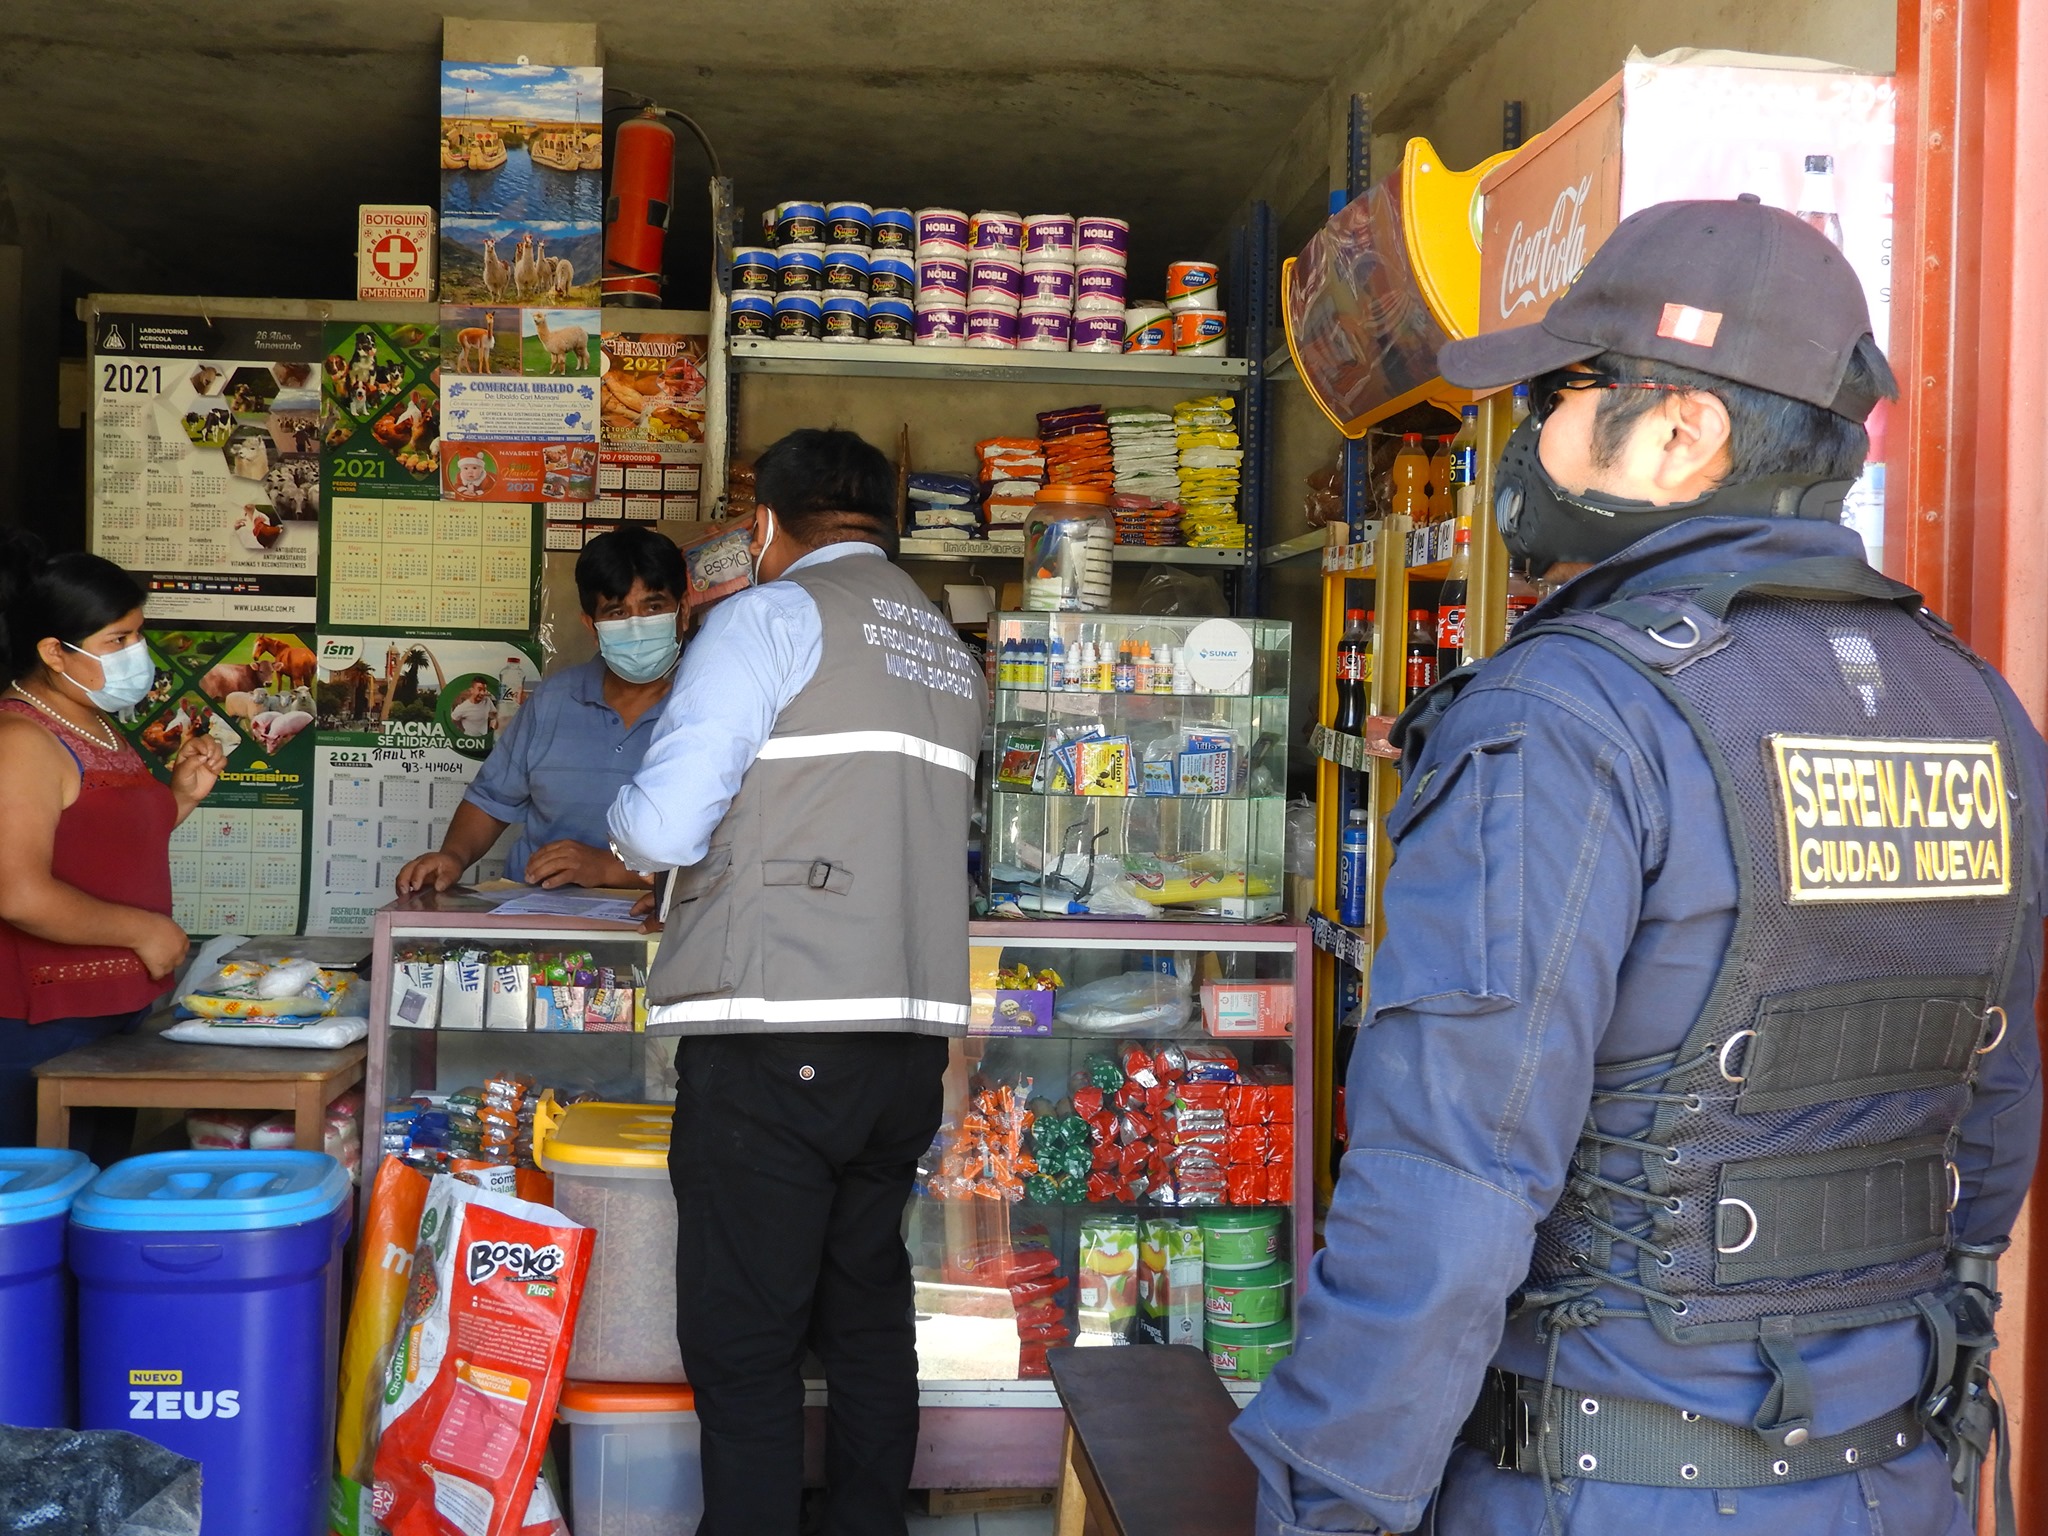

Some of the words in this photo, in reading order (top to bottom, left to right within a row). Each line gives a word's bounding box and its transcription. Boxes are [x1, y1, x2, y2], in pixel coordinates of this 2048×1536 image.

[366, 214, 426, 226] BOTIQUIN
[925, 223, 956, 232] NOBLE
[986, 225, 1014, 235] NOBLE
[1036, 226, 1064, 236] NOBLE
[1084, 228, 1114, 239] NOBLE
[366, 228, 424, 254] PRIMEROS
[369, 270, 420, 288] AUXILIOS
[927, 270, 957, 280] NOBLE
[978, 270, 1008, 281] NOBLE
[1033, 275, 1061, 285] NOBLE
[1082, 277, 1112, 286] NOBLE
[362, 288, 425, 298] EMERGENCIA
[928, 314, 956, 324] NOBLE
[970, 318, 1000, 327] NOBLE
[1032, 317, 1060, 327] NOBLE
[139, 327, 188, 335] LABORATORIOS
[1090, 322, 1117, 331] NOBLE
[139, 343, 186, 351] VETERINARIOS
[623, 357, 667, 371] 2021
[103, 363, 162, 394] 2021
[470, 382, 530, 392] COMERCIAL
[532, 383, 574, 393] UBALDO
[333, 458, 385, 478] 2021
[507, 482, 535, 492] 2021
[704, 550, 749, 575] Dkasa
[872, 598, 911, 626] EQUIPO
[863, 624, 880, 645] DE
[927, 667, 972, 699] ENCARGADO
[382, 721, 445, 737] TACNA
[378, 736, 394, 746] SE
[397, 737, 453, 748] HIDRATA
[456, 738, 485, 749] CON
[330, 752, 367, 762] 2021
[219, 769, 299, 782] tomasino
[1788, 751, 1998, 829] SERENAZGO
[1801, 838, 1900, 882] CIUDAD
[1915, 840, 2000, 881] NUEVA
[330, 916, 366, 924] PRODUCTOS
[527, 1284, 550, 1295] Plus
[134, 1374, 178, 1382] NUEVO
[129, 1389, 240, 1419] ZEUS
